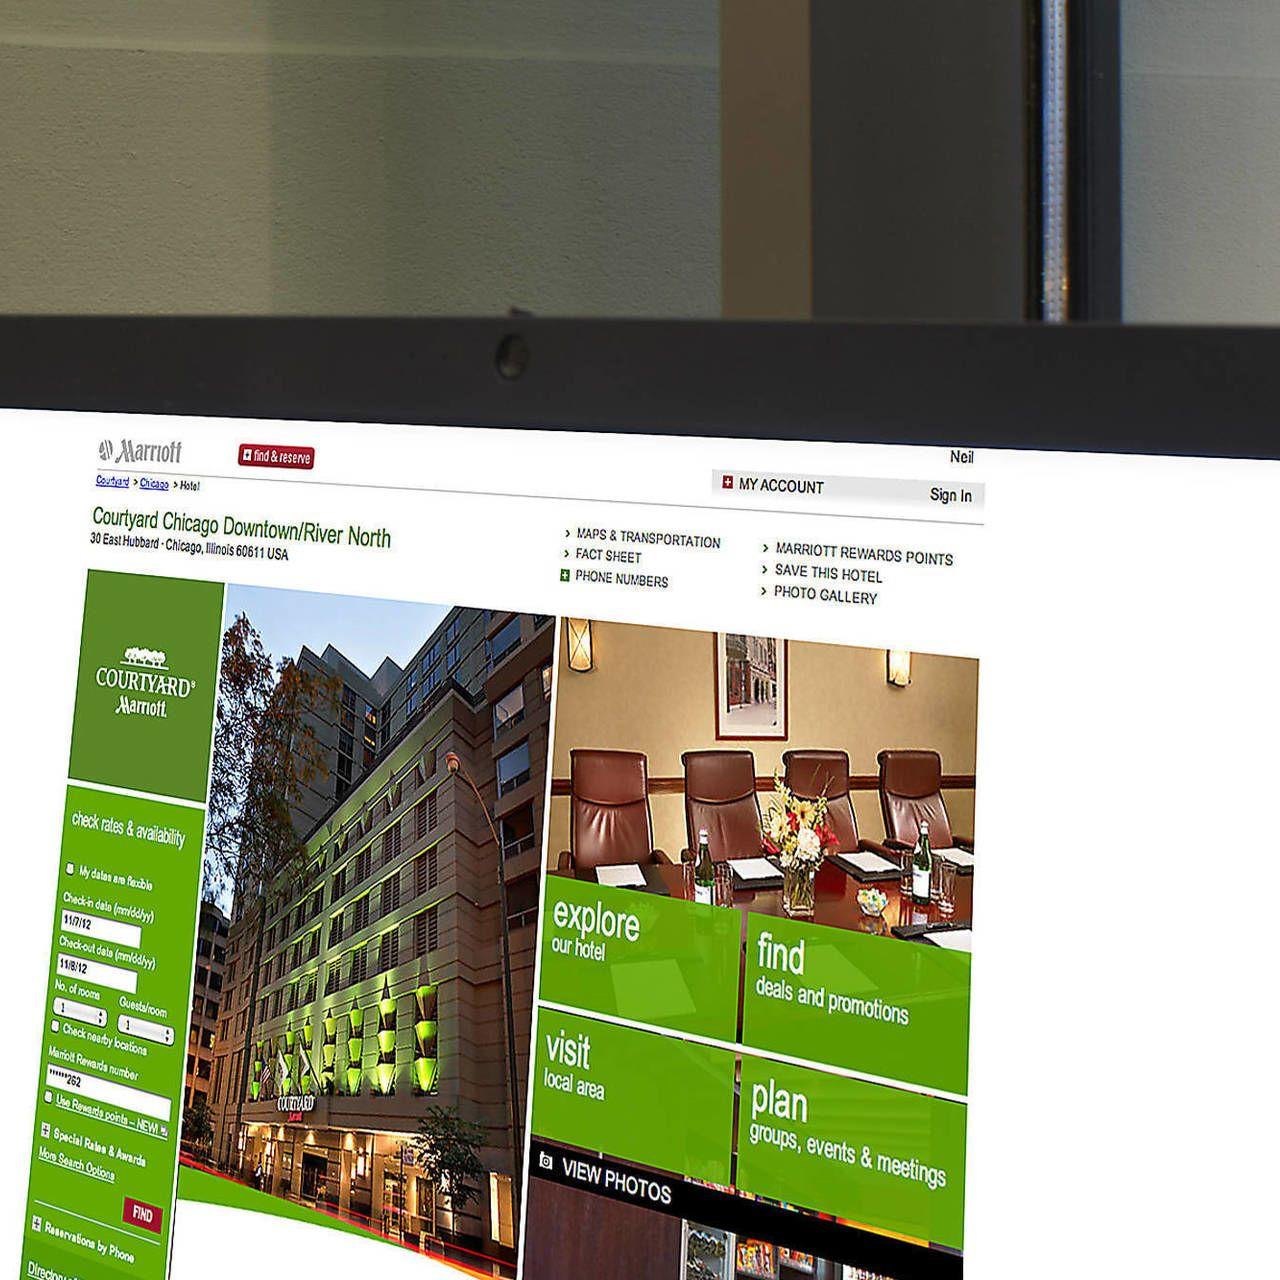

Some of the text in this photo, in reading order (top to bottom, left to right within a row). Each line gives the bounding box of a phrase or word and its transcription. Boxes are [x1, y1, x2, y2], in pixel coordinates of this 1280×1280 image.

[115, 438, 182, 465] Marriott
[253, 449, 313, 467] find & reserve
[950, 449, 973, 463] Neil
[96, 474, 200, 491] Courtyard Chicago Hotel
[739, 477, 823, 493] MY ACCOUNT
[930, 487, 971, 504] Sign In
[93, 506, 390, 547] Courtyard Chicago Downtown/River North
[577, 527, 720, 548] MAPS & TRANSPORTATION
[90, 531, 288, 560] 30 East Hubbard Chicago, Illinois 60611 USA
[576, 547, 641, 563] FACT SHEET
[776, 542, 953, 565] MARRIOTT REWARDS POINTS
[575, 569, 668, 587] PHONE NUMBERS
[775, 563, 882, 583] SAVE THIS HOTEL
[774, 584, 877, 604] PHOTO GALLERY
[554, 902, 638, 940] explore
[551, 937, 607, 962] our hotel
[757, 932, 805, 974] find
[756, 976, 908, 1024] deals and promotions
[546, 1030, 589, 1068] visit
[543, 1067, 606, 1101] local area
[752, 1080, 806, 1121] plan
[749, 1123, 945, 1189] groups, events & meetings
[562, 1158, 670, 1203] VIEW PHOTOS
[133, 1205, 152, 1222] FIND
